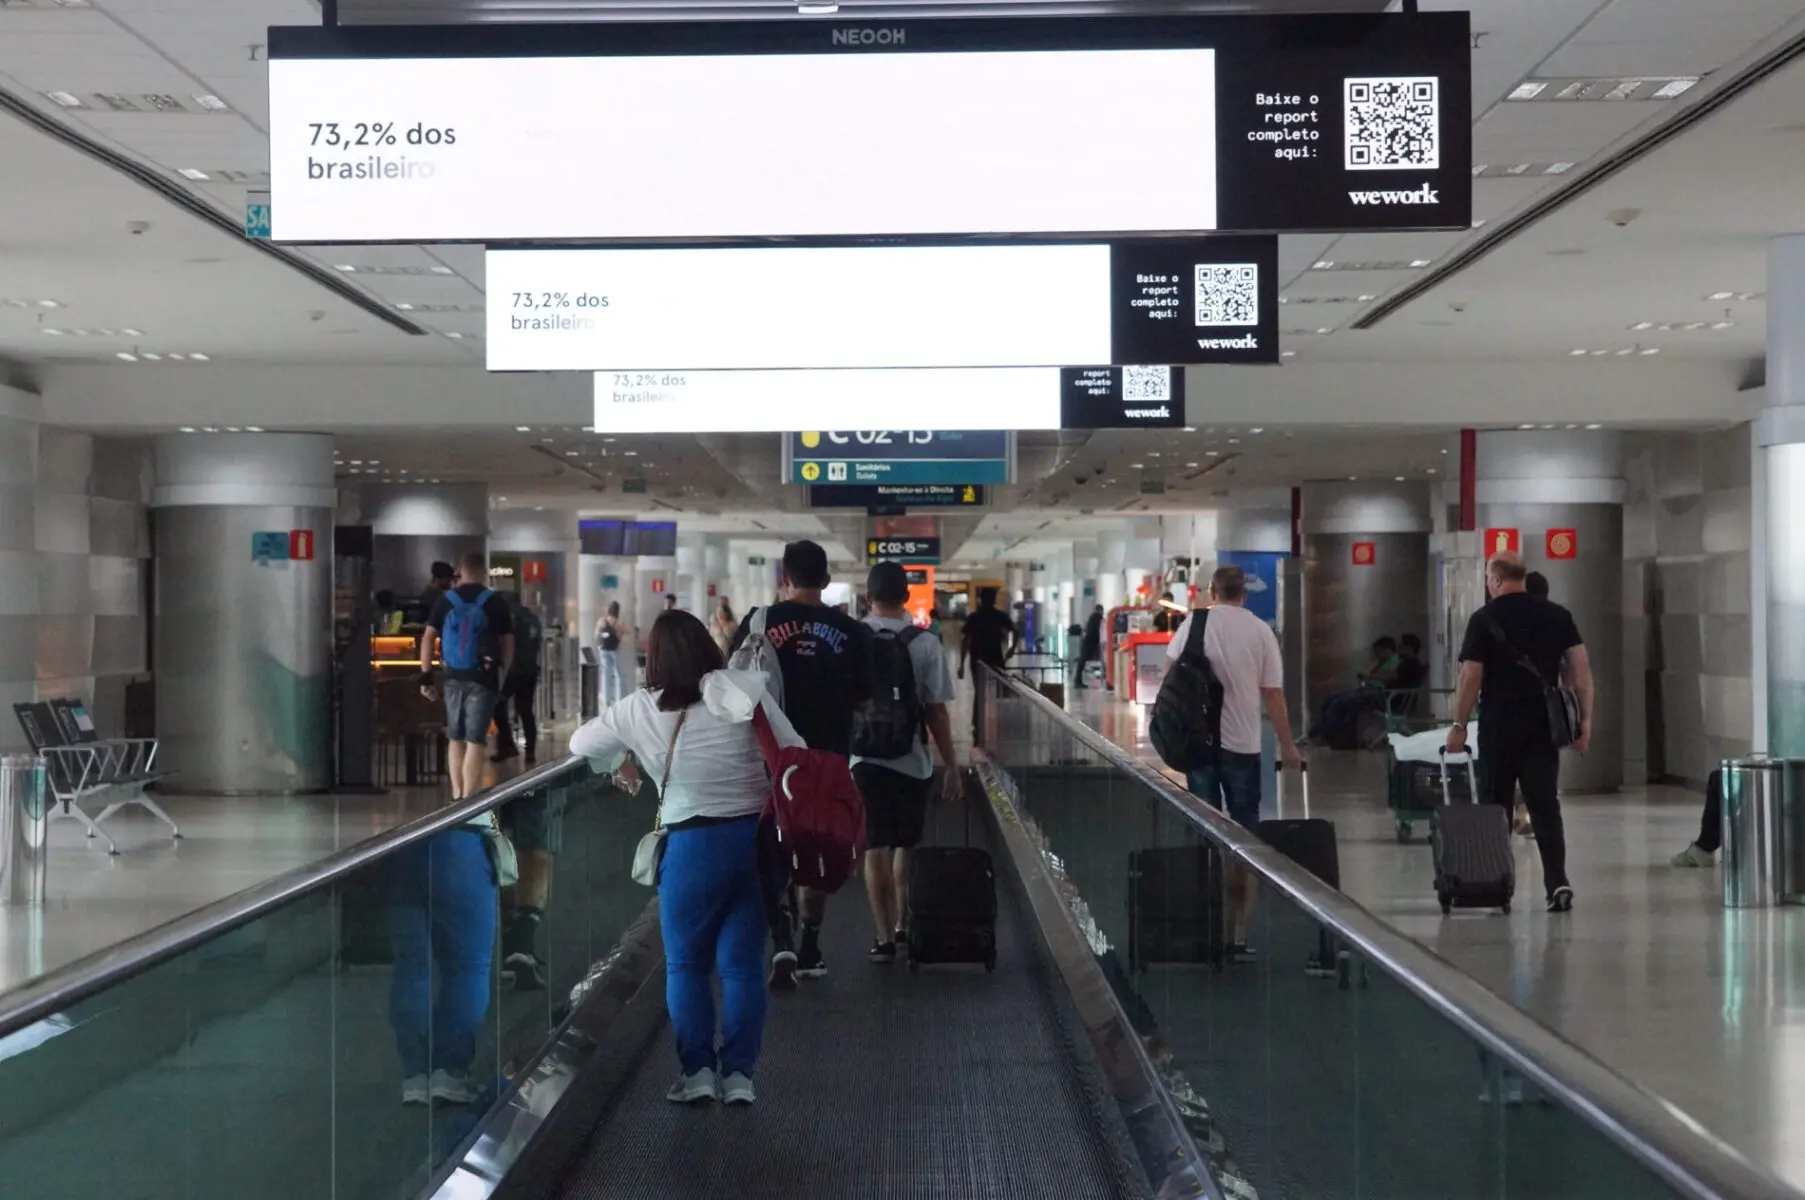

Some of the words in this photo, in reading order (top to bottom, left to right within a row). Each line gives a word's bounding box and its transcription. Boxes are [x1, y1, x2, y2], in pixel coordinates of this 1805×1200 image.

[832, 28, 906, 45] NEOOH
[1256, 93, 1301, 105] Baixe
[1309, 94, 1319, 104] o
[1265, 111, 1319, 125] report
[308, 122, 397, 150] 73,2%
[406, 122, 456, 145] dos
[1248, 129, 1319, 143] completo
[1274, 146, 1317, 160] aqui:
[1349, 182, 1440, 205] wework
[1136, 274, 1167, 283] Baixe
[1142, 286, 1178, 296] report
[511, 292, 570, 311] 73,2%
[576, 292, 609, 308] dos
[1131, 298, 1179, 307] completo
[1149, 309, 1178, 319] aqui:
[1198, 333, 1257, 349] wework
[613, 374, 657, 389] 73,2%
[661, 374, 686, 386] dos
[1083, 370, 1110, 379] report
[1074, 379, 1112, 387] completo
[1124, 405, 1170, 418] wework
[767, 620, 848, 654] BILLABONG
